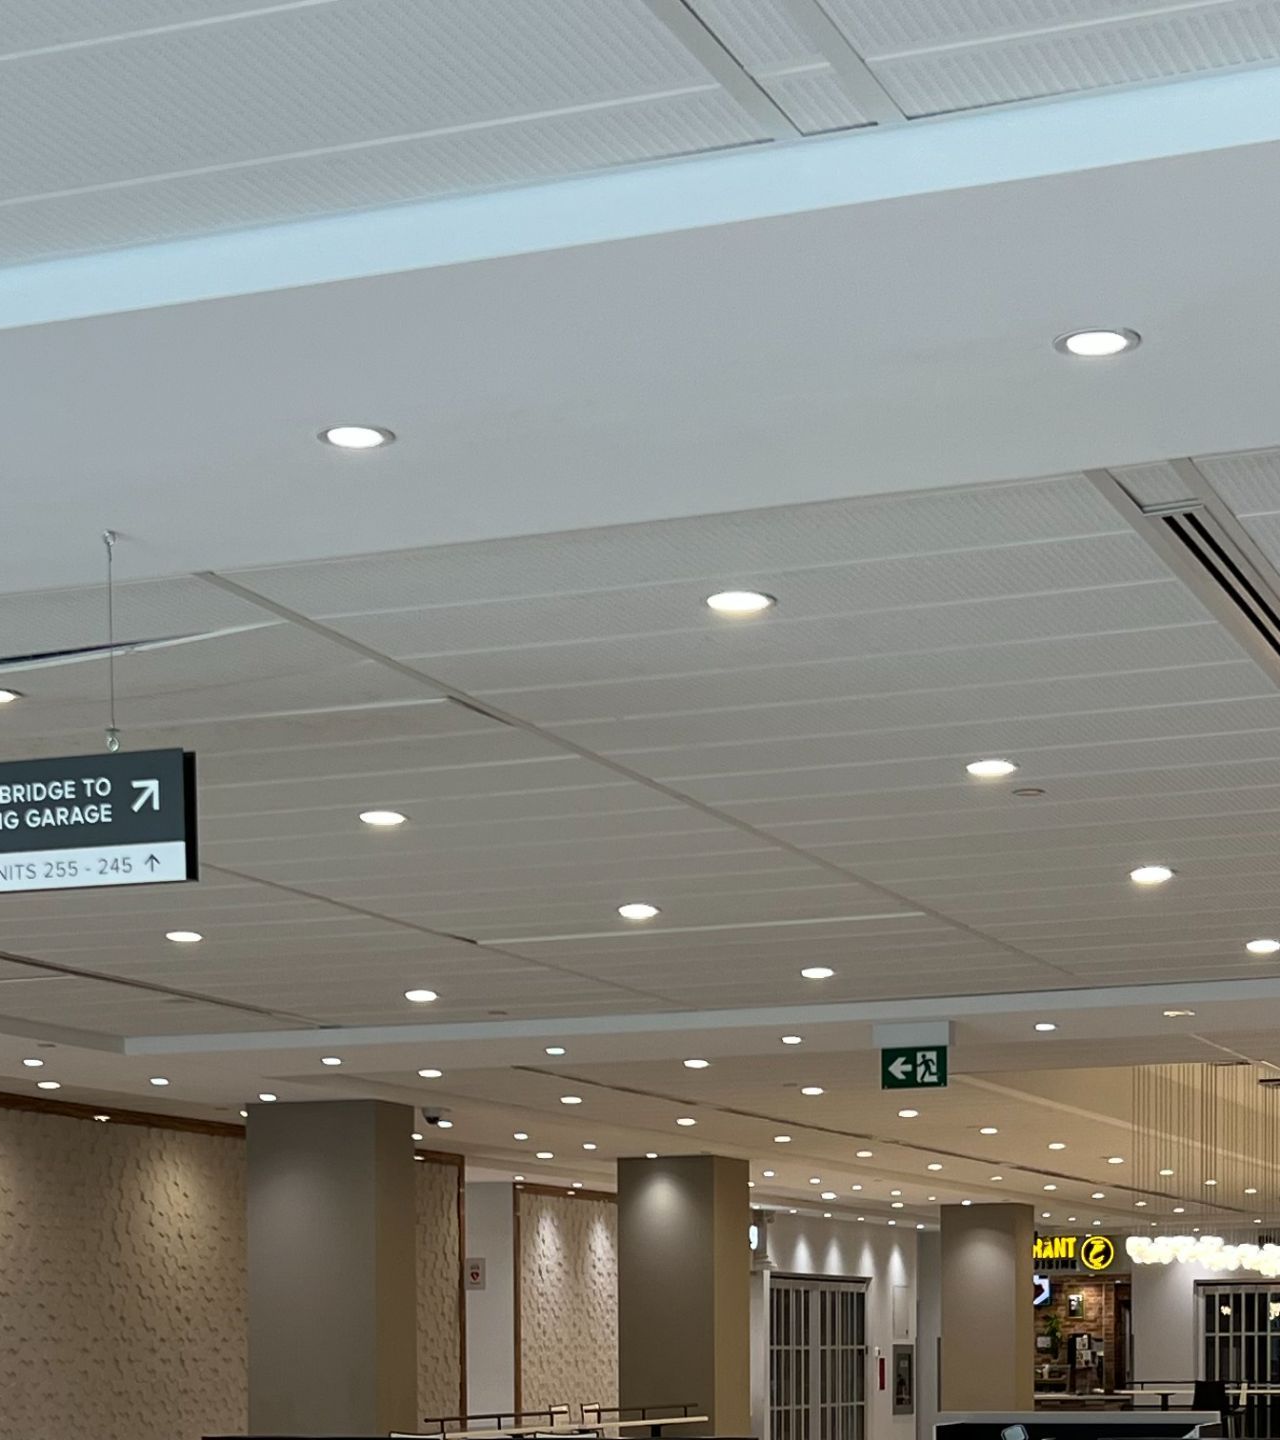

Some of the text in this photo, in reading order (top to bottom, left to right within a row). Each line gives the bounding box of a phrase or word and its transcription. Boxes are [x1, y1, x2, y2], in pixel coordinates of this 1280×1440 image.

[81, 777, 111, 798] TO
[25, 803, 113, 828] GARAGE
[44, 859, 79, 878] 255
[98, 857, 133, 876] 245
